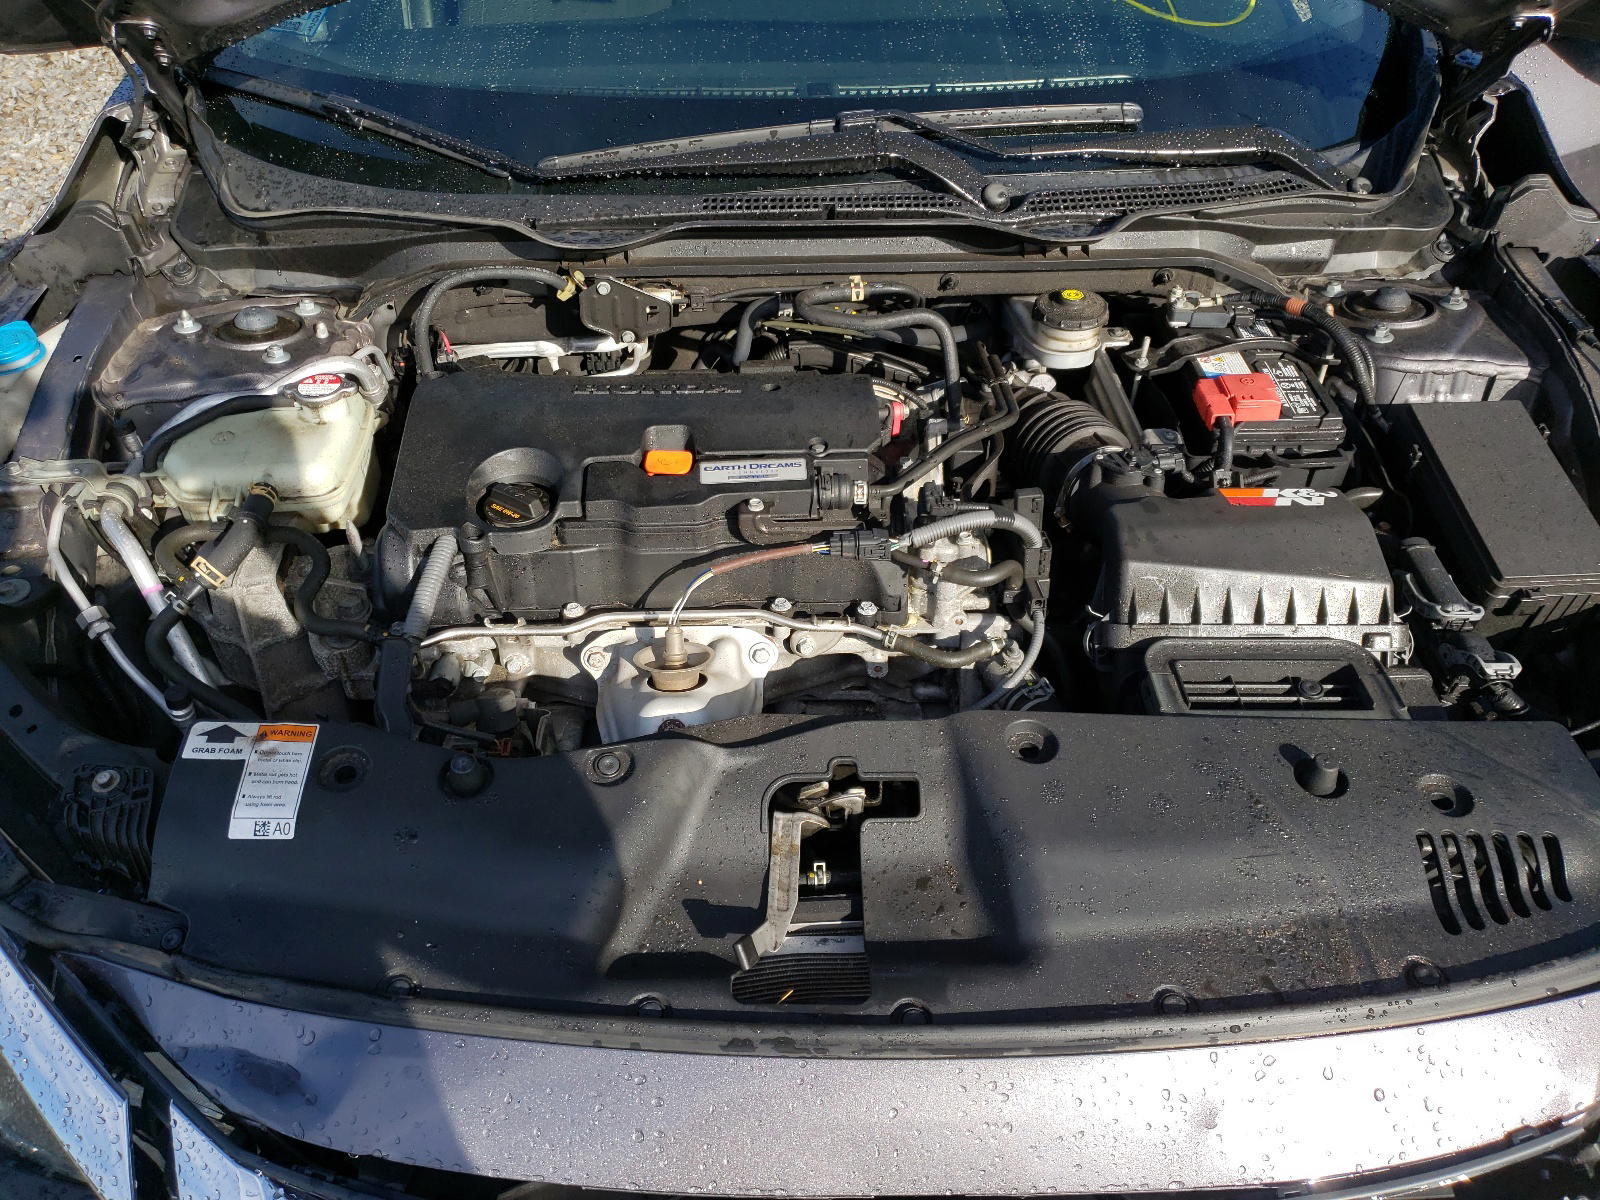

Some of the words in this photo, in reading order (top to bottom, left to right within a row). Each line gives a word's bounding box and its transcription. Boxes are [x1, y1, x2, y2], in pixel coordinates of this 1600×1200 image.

[703, 464, 747, 472] EARTH
[749, 461, 802, 470] DREAMS
[490, 503, 503, 511] SAE
[270, 729, 313, 738] WARNING
[217, 747, 243, 755] FOAM
[272, 822, 291, 836] A0
